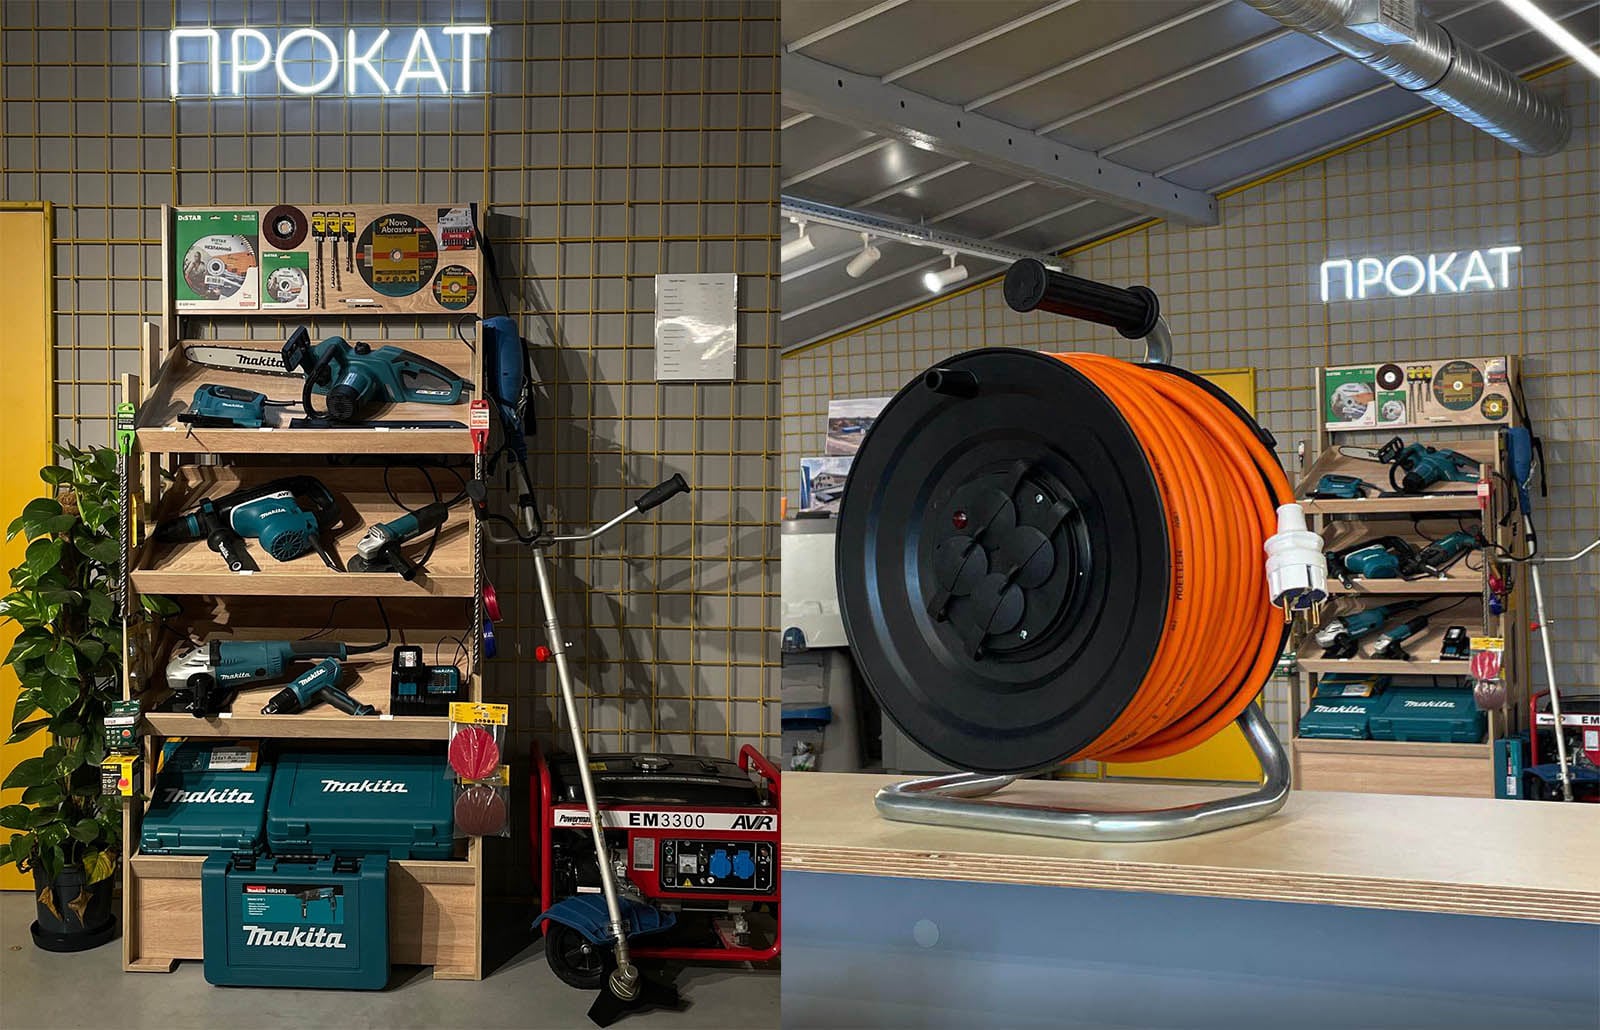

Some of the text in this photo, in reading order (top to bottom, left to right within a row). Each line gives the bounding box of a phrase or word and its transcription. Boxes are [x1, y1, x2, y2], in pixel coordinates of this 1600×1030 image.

[169, 26, 493, 95] ПРОКАТ
[381, 226, 412, 234] Abrasive
[388, 218, 408, 227] Novo
[1320, 245, 1523, 303] ПРОКАТ
[730, 814, 774, 831] AVR
